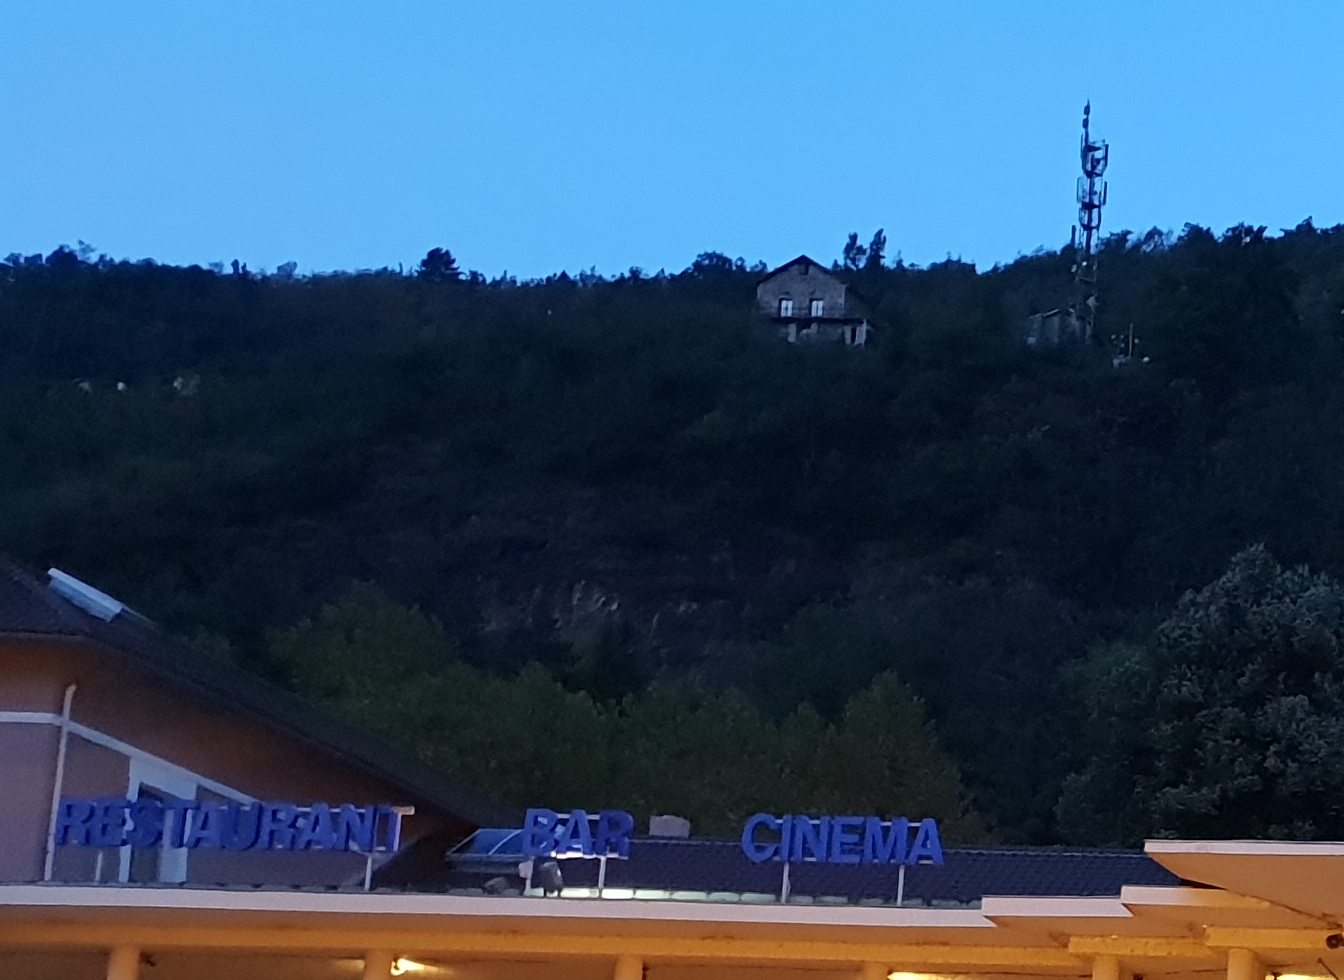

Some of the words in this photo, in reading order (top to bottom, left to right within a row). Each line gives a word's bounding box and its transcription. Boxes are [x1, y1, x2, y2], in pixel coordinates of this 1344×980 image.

[56, 800, 398, 851] RESTAURANT
[523, 808, 634, 859] BAR
[742, 813, 944, 865] CINEMA
